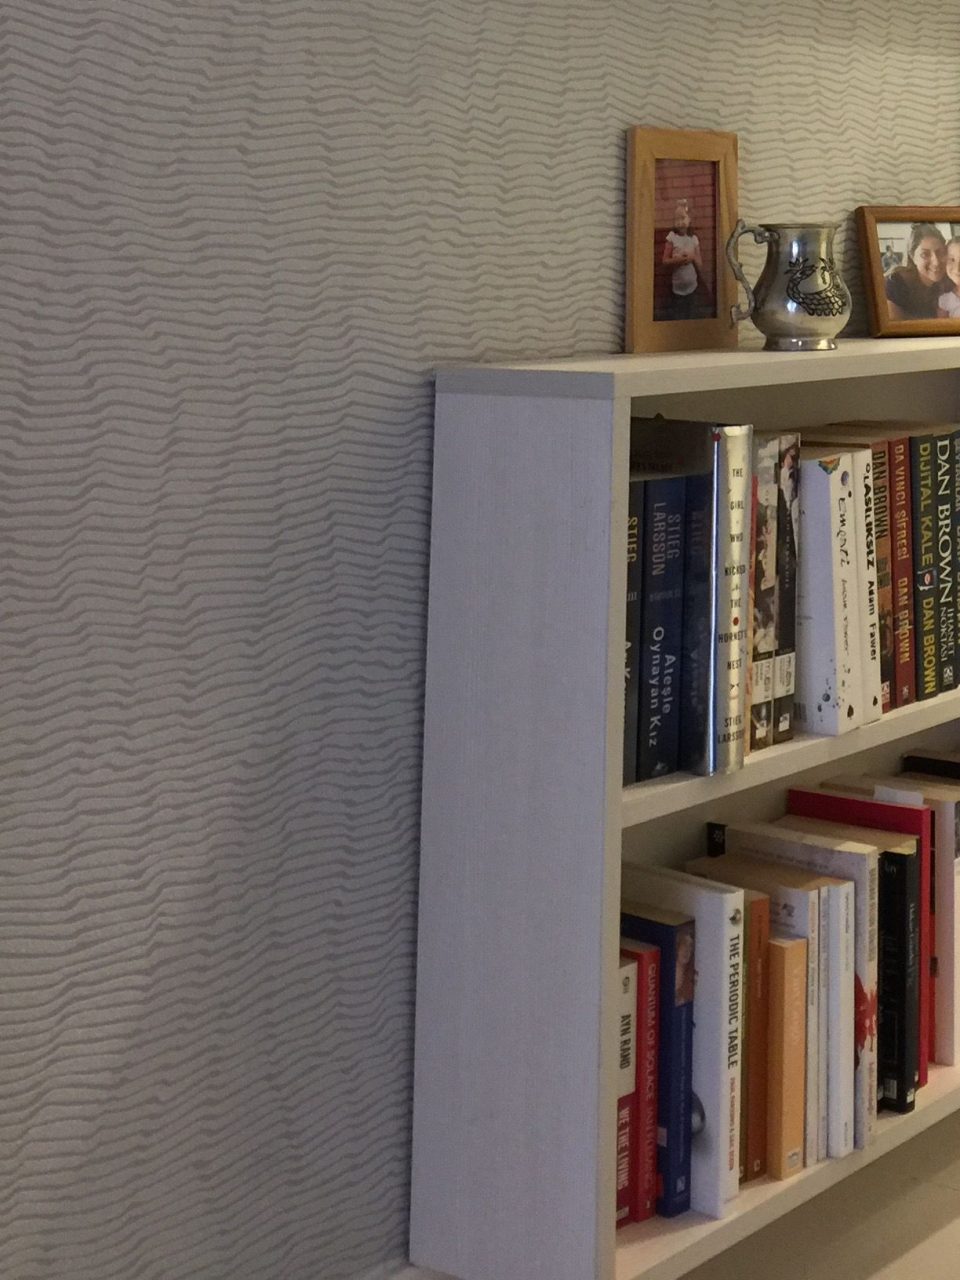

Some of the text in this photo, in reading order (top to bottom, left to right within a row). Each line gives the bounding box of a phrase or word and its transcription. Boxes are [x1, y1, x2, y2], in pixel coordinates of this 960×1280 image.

[733, 468, 743, 477] THE
[894, 444, 904, 462] DA
[937, 439, 950, 496] DAN
[872, 450, 888, 540] DAN BROWN
[652, 502, 666, 576] LARSSON
[667, 514, 680, 559] STIEG
[921, 516, 934, 566] KALE
[939, 505, 954, 608] BROWN
[867, 580, 877, 616] Adam
[897, 576, 908, 606] DAN
[923, 596, 936, 624] DAN
[868, 622, 879, 662] Fawer
[898, 610, 910, 664] BROWN
[924, 630, 938, 693] BROWN
[648, 626, 676, 748] Ateşle Oynayan Kız
[729, 933, 740, 961] THE
[646, 963, 657, 1026] QUANTUM
[728, 962, 740, 1025] PERIODIC
[620, 1014, 632, 1035] AYN
[647, 1029, 657, 1045] OF
[620, 1037, 632, 1070] RAND
[727, 1028, 739, 1070] TABLE
[646, 1050, 656, 1101] SOLACE
[618, 1108, 630, 1125] WE
